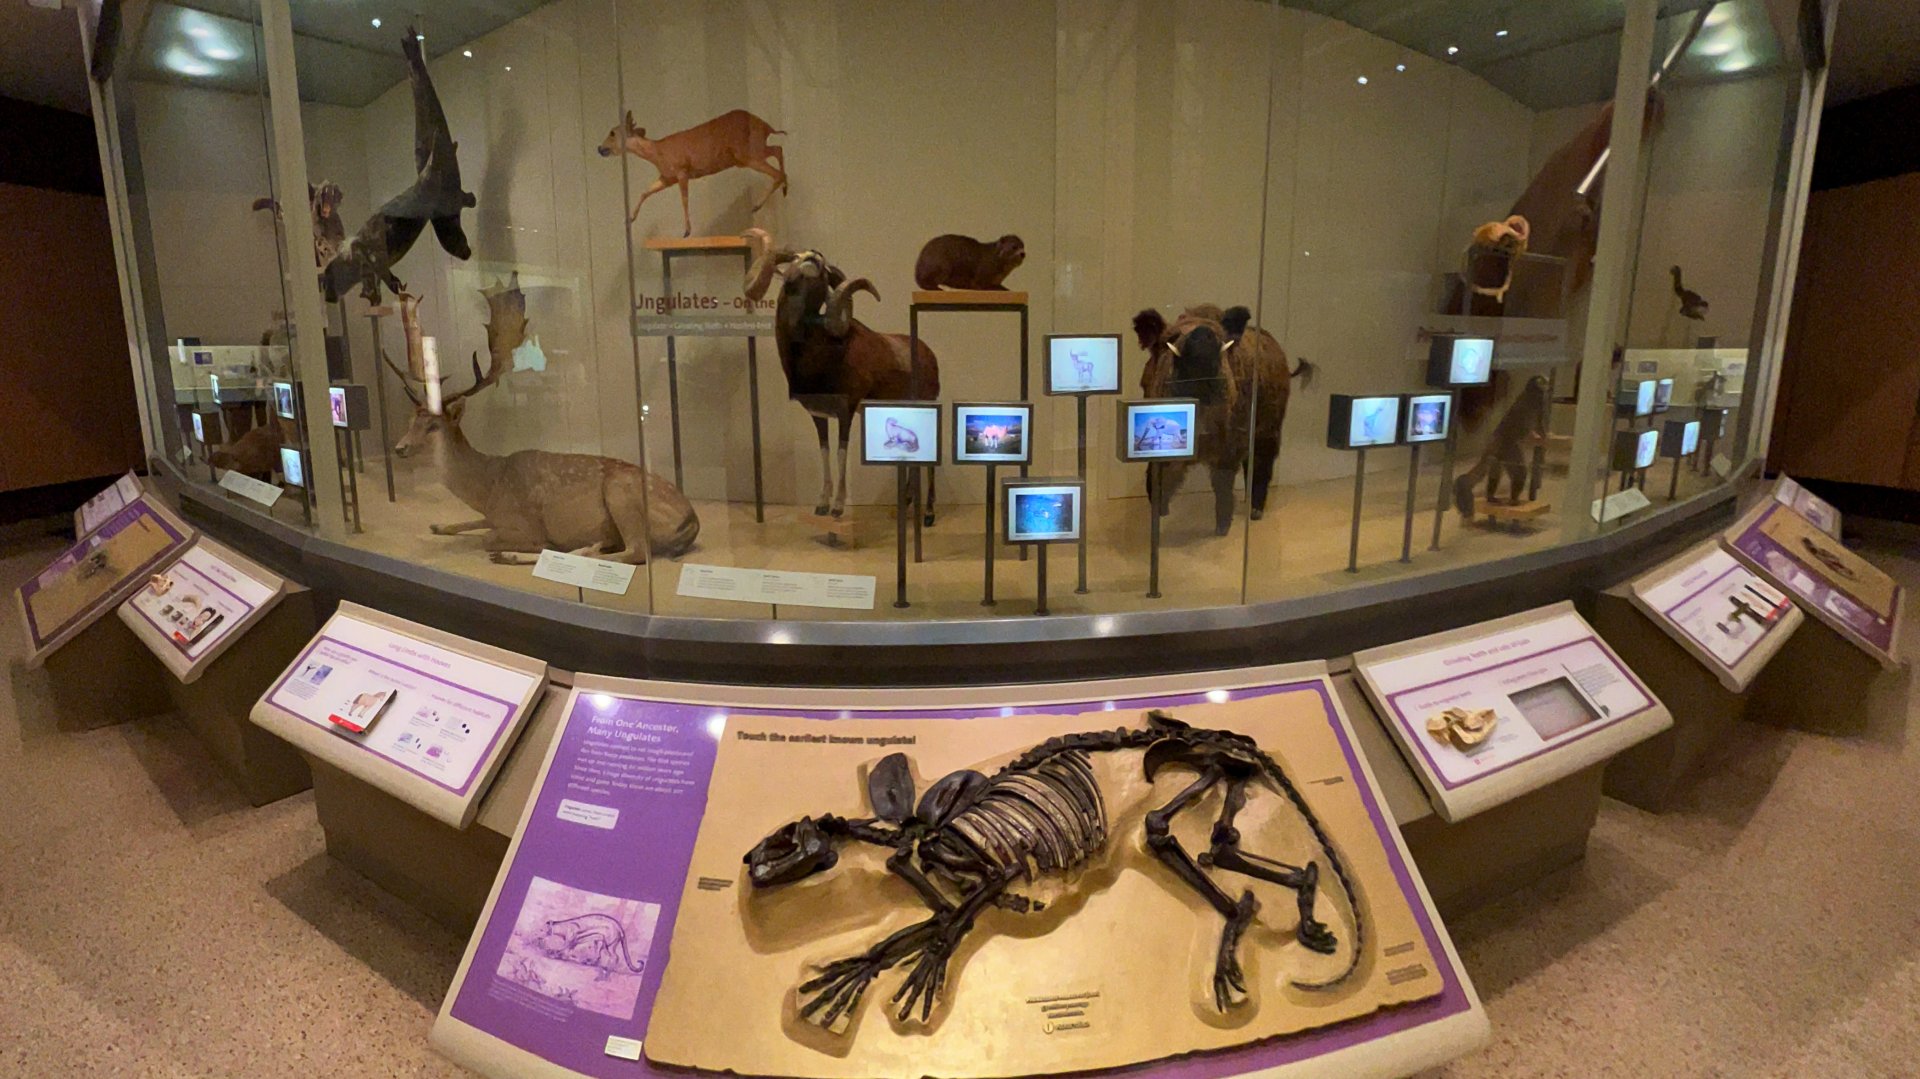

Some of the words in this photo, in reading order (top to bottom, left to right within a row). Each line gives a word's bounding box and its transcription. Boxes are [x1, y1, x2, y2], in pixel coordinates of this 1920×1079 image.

[733, 296, 753, 309] On
[755, 297, 775, 309] the
[591, 715, 614, 726] From
[616, 719, 633, 729] One
[587, 726, 613, 739] Many
[614, 727, 661, 742] Ungulates
[737, 730, 767, 742] Touch
[769, 732, 786, 742] the
[788, 734, 827, 744] earliest
[829, 735, 864, 745] known
[866, 735, 916, 747] ungulate!
